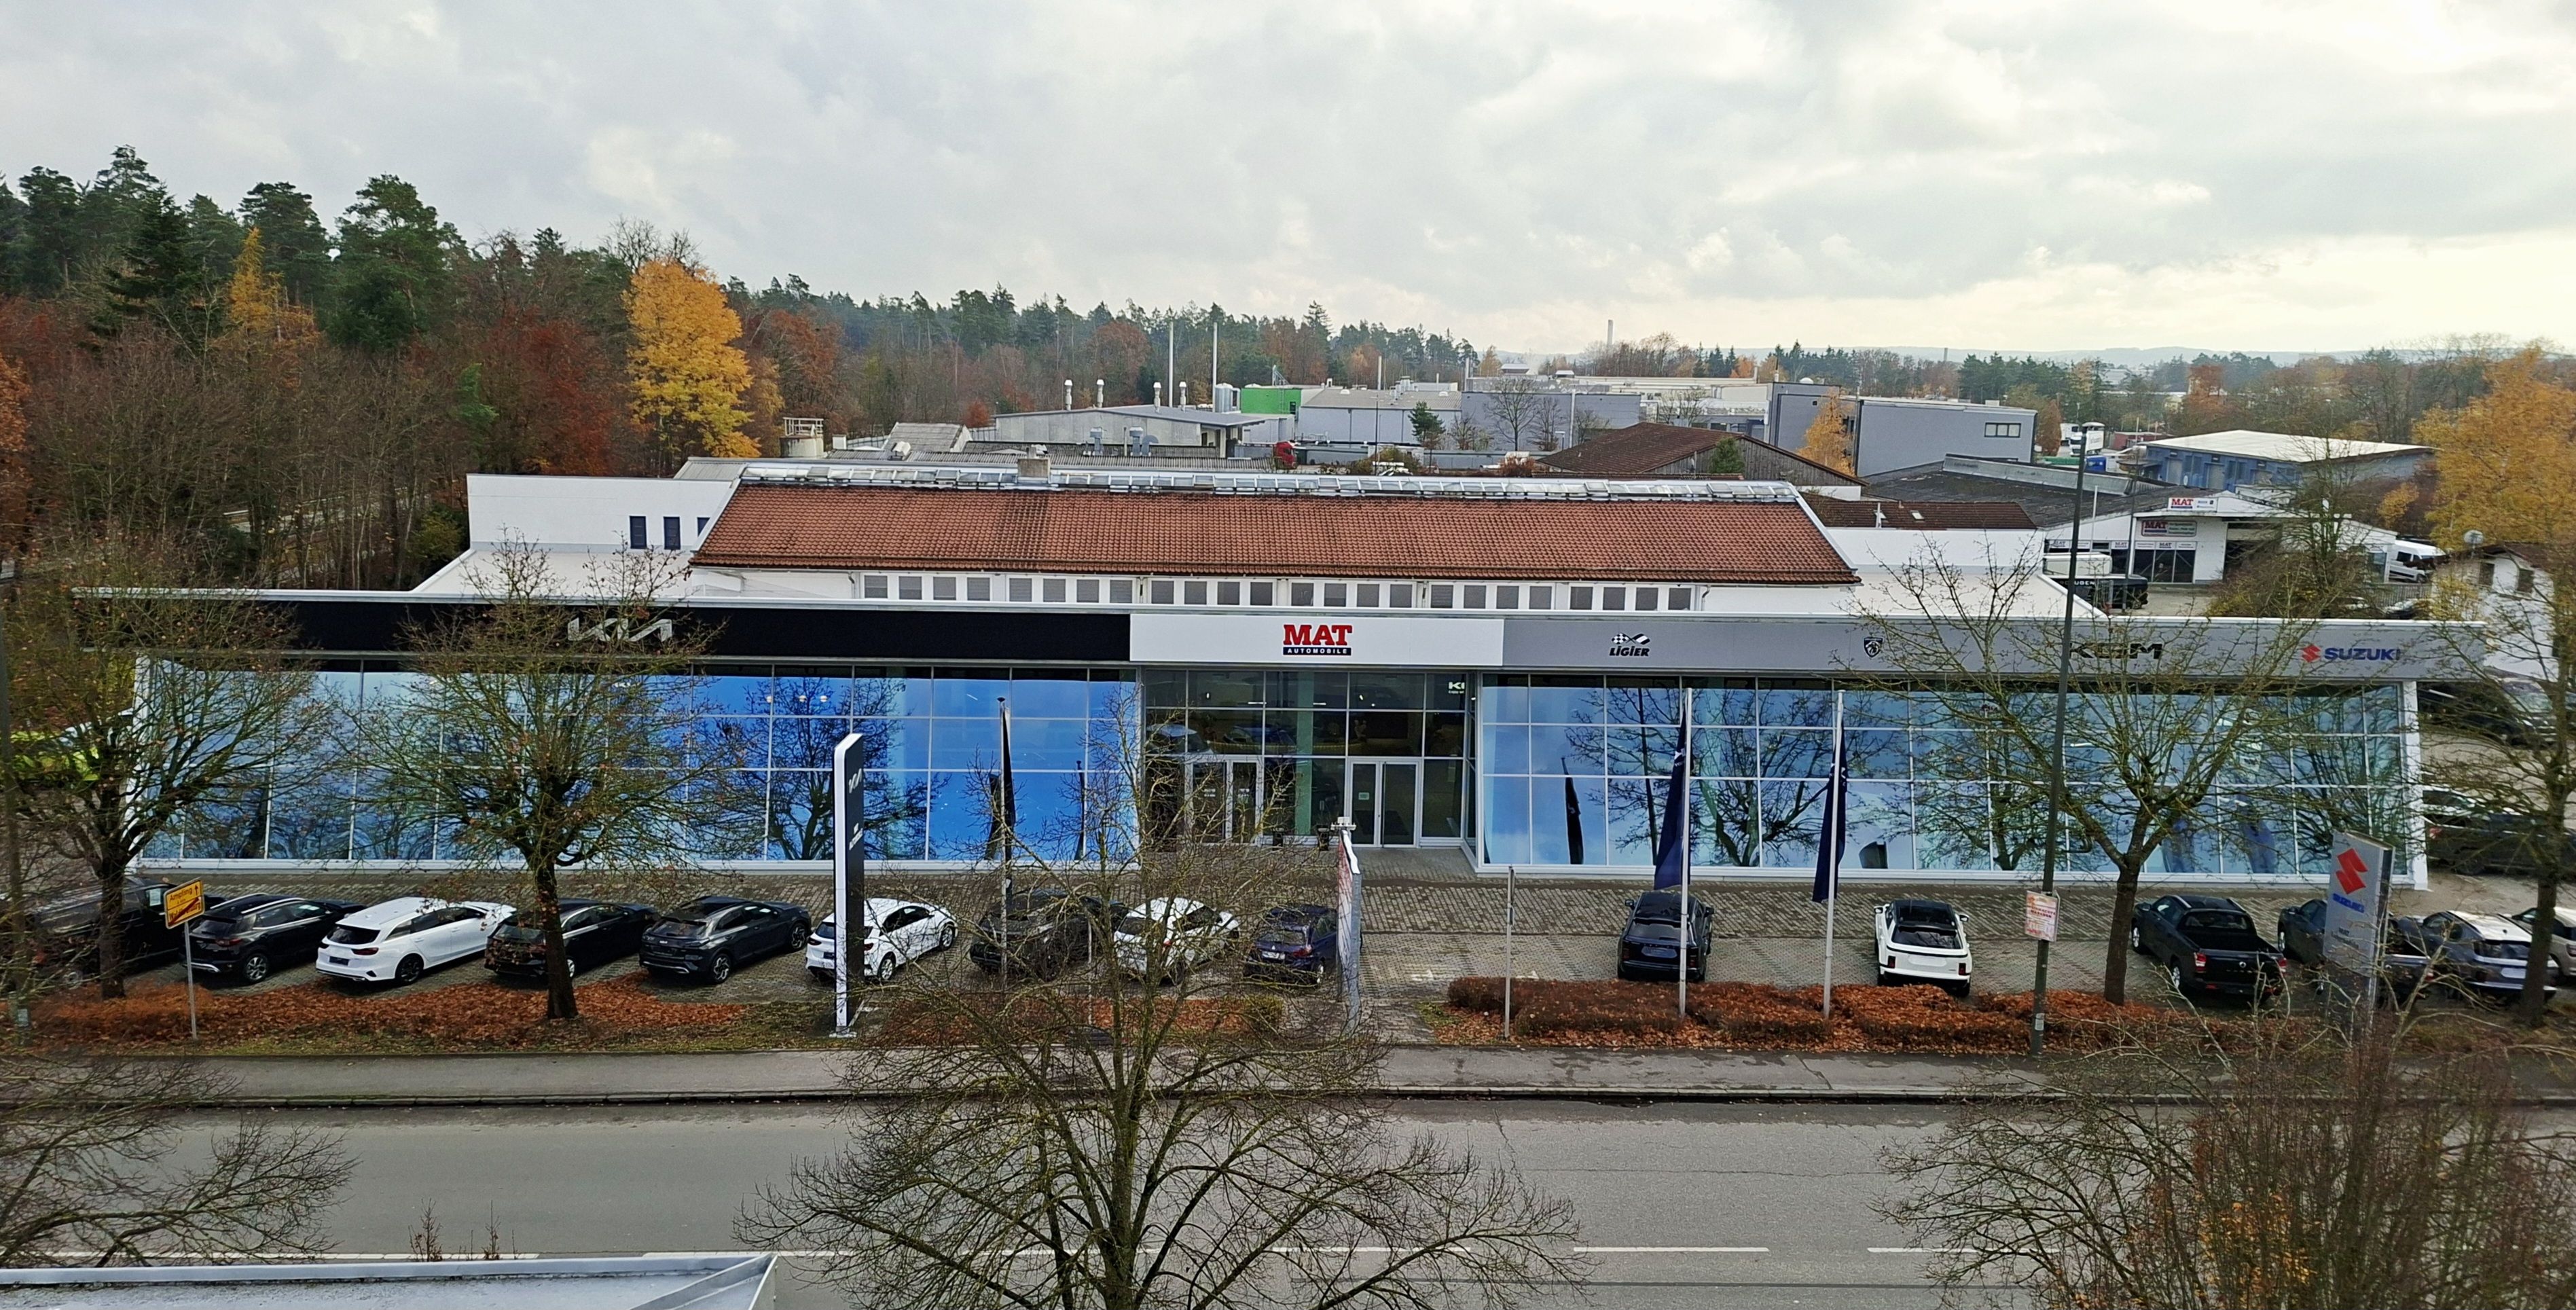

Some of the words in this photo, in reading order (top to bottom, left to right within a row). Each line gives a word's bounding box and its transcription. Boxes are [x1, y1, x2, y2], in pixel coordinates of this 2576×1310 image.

[1283, 624, 1353, 646] MAT
[1609, 646, 1650, 657] LIGIER
[2069, 642, 2163, 659] KGM
[2324, 647, 2401, 661] SUZUKI
